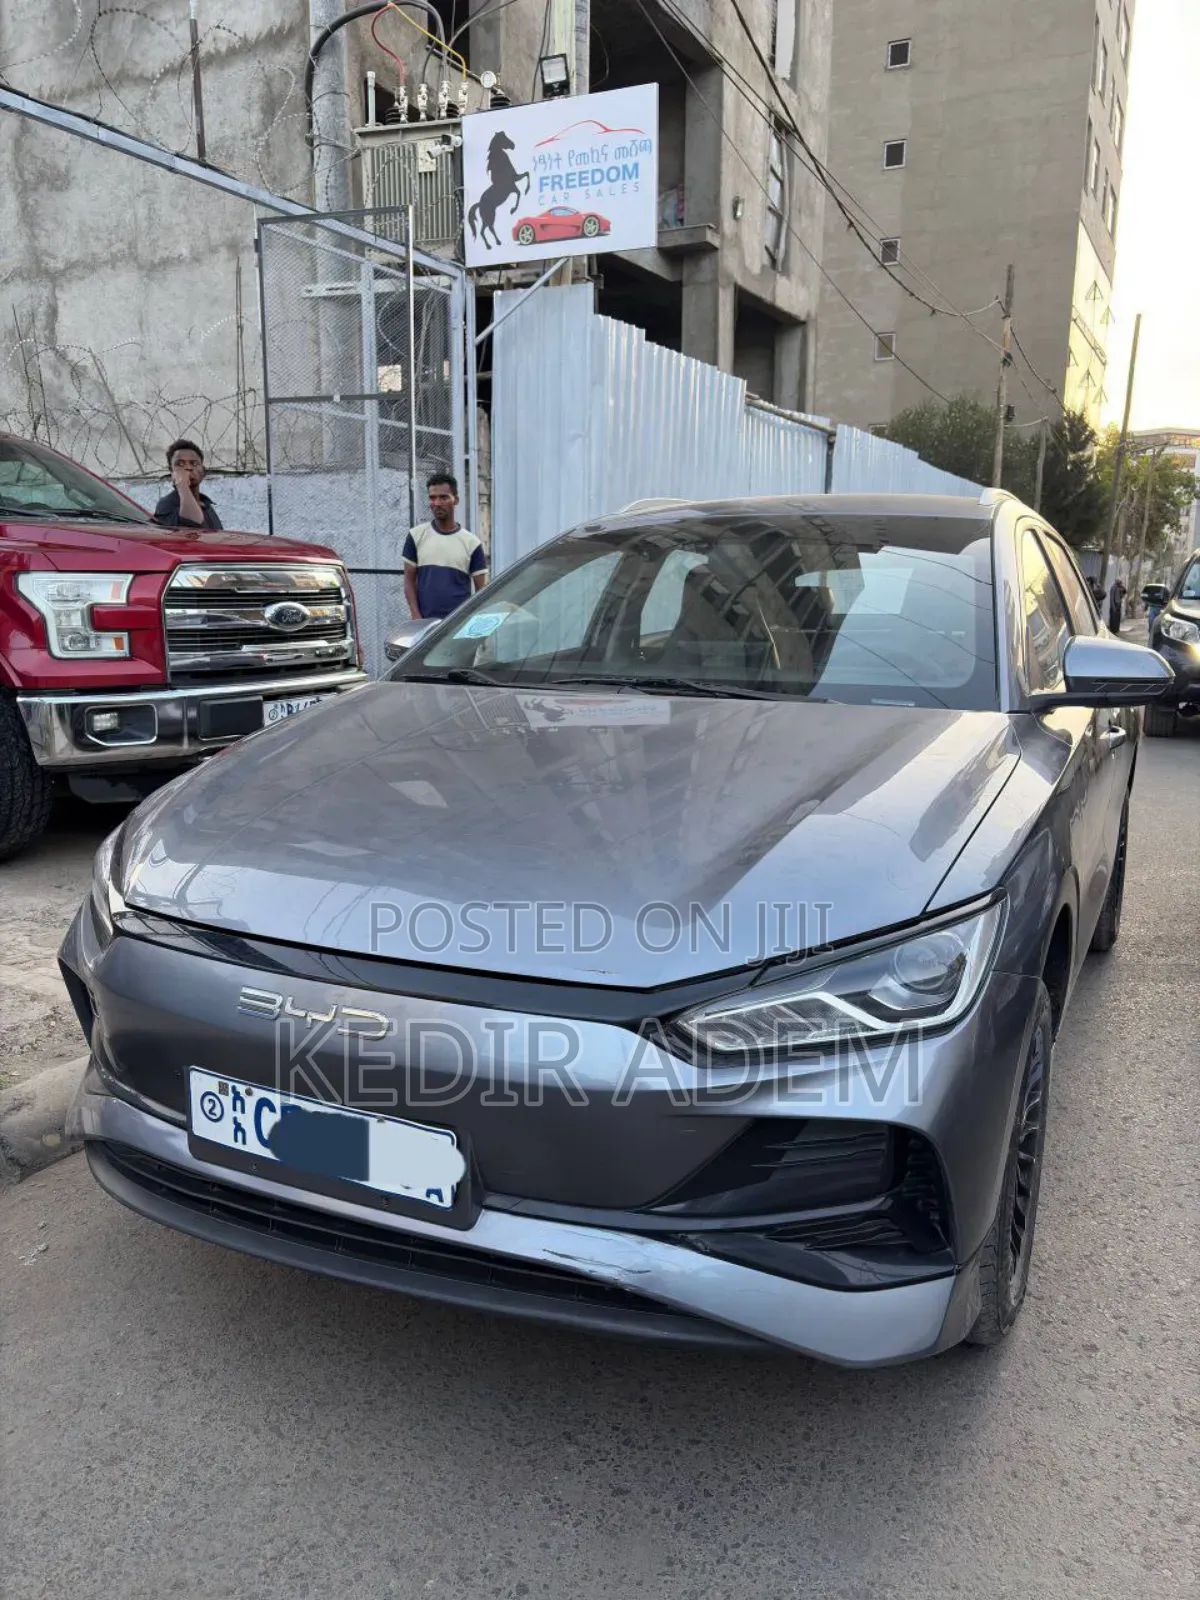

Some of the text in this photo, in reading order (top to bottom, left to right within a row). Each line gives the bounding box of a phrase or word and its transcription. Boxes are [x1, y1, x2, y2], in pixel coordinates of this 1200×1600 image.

[539, 162, 640, 193] FREEDOM
[538, 182, 640, 206] CAR SALES
[236, 985, 392, 1042] BYD
